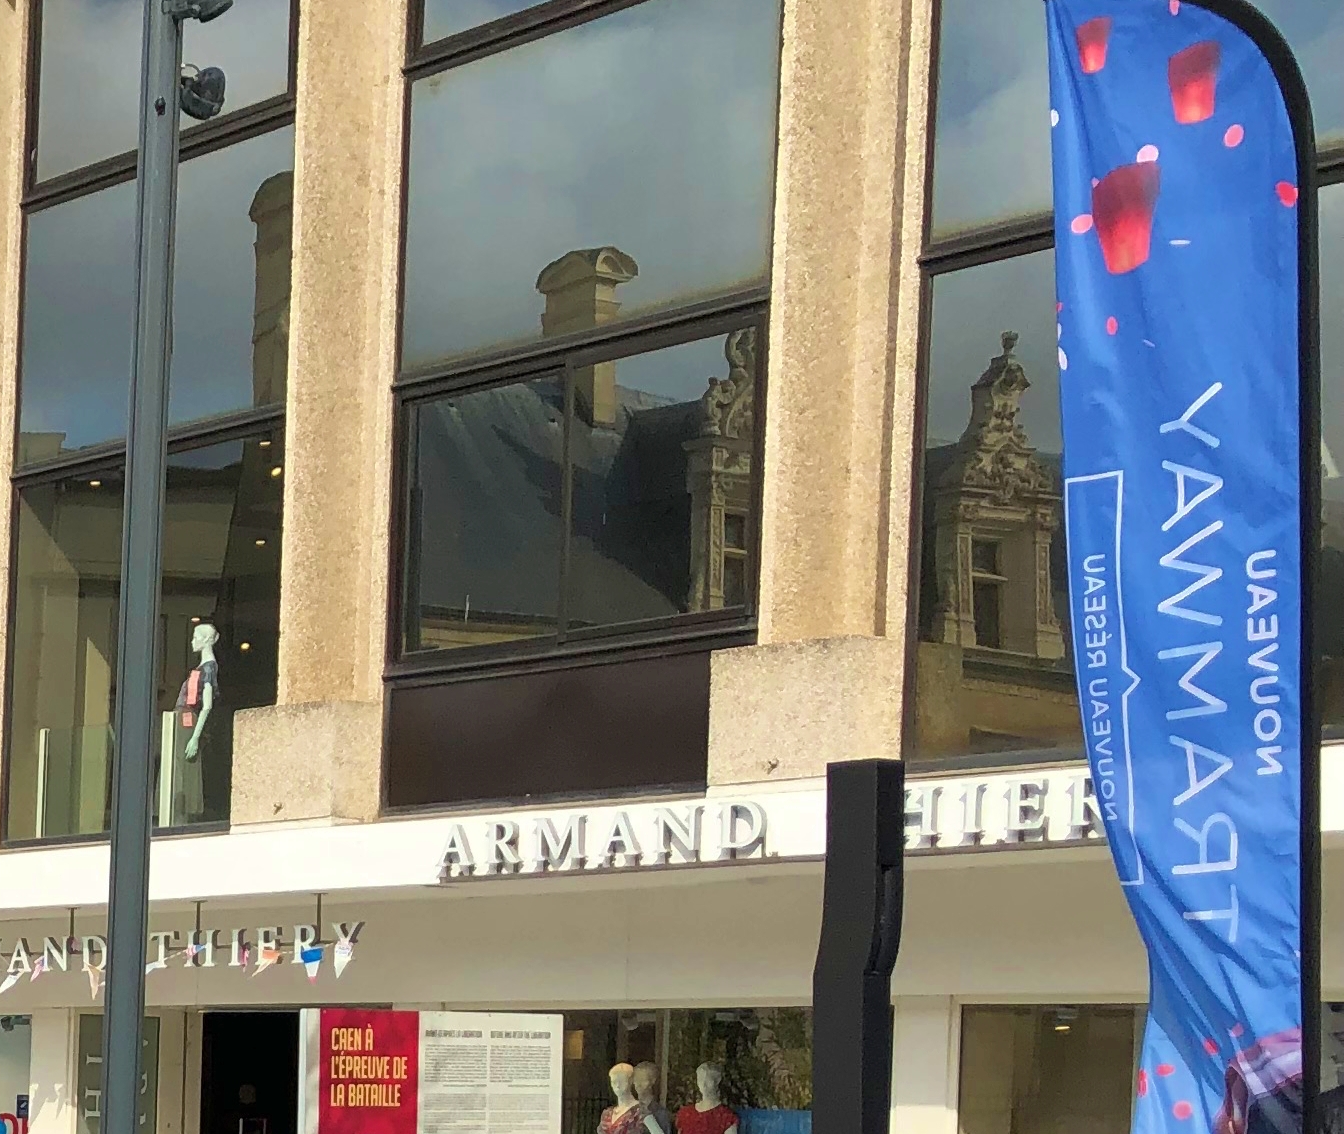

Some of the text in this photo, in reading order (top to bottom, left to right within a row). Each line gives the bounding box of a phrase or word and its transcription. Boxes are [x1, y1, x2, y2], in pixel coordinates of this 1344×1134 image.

[436, 801, 768, 870] ARMAND
[148, 922, 361, 969] THIERY
[331, 1023, 374, 1051] CAEN À
[331, 1051, 391, 1079] L'ÉPREUVE
[393, 1056, 408, 1079] DE
[331, 1083, 401, 1107] LA BATAILLE
